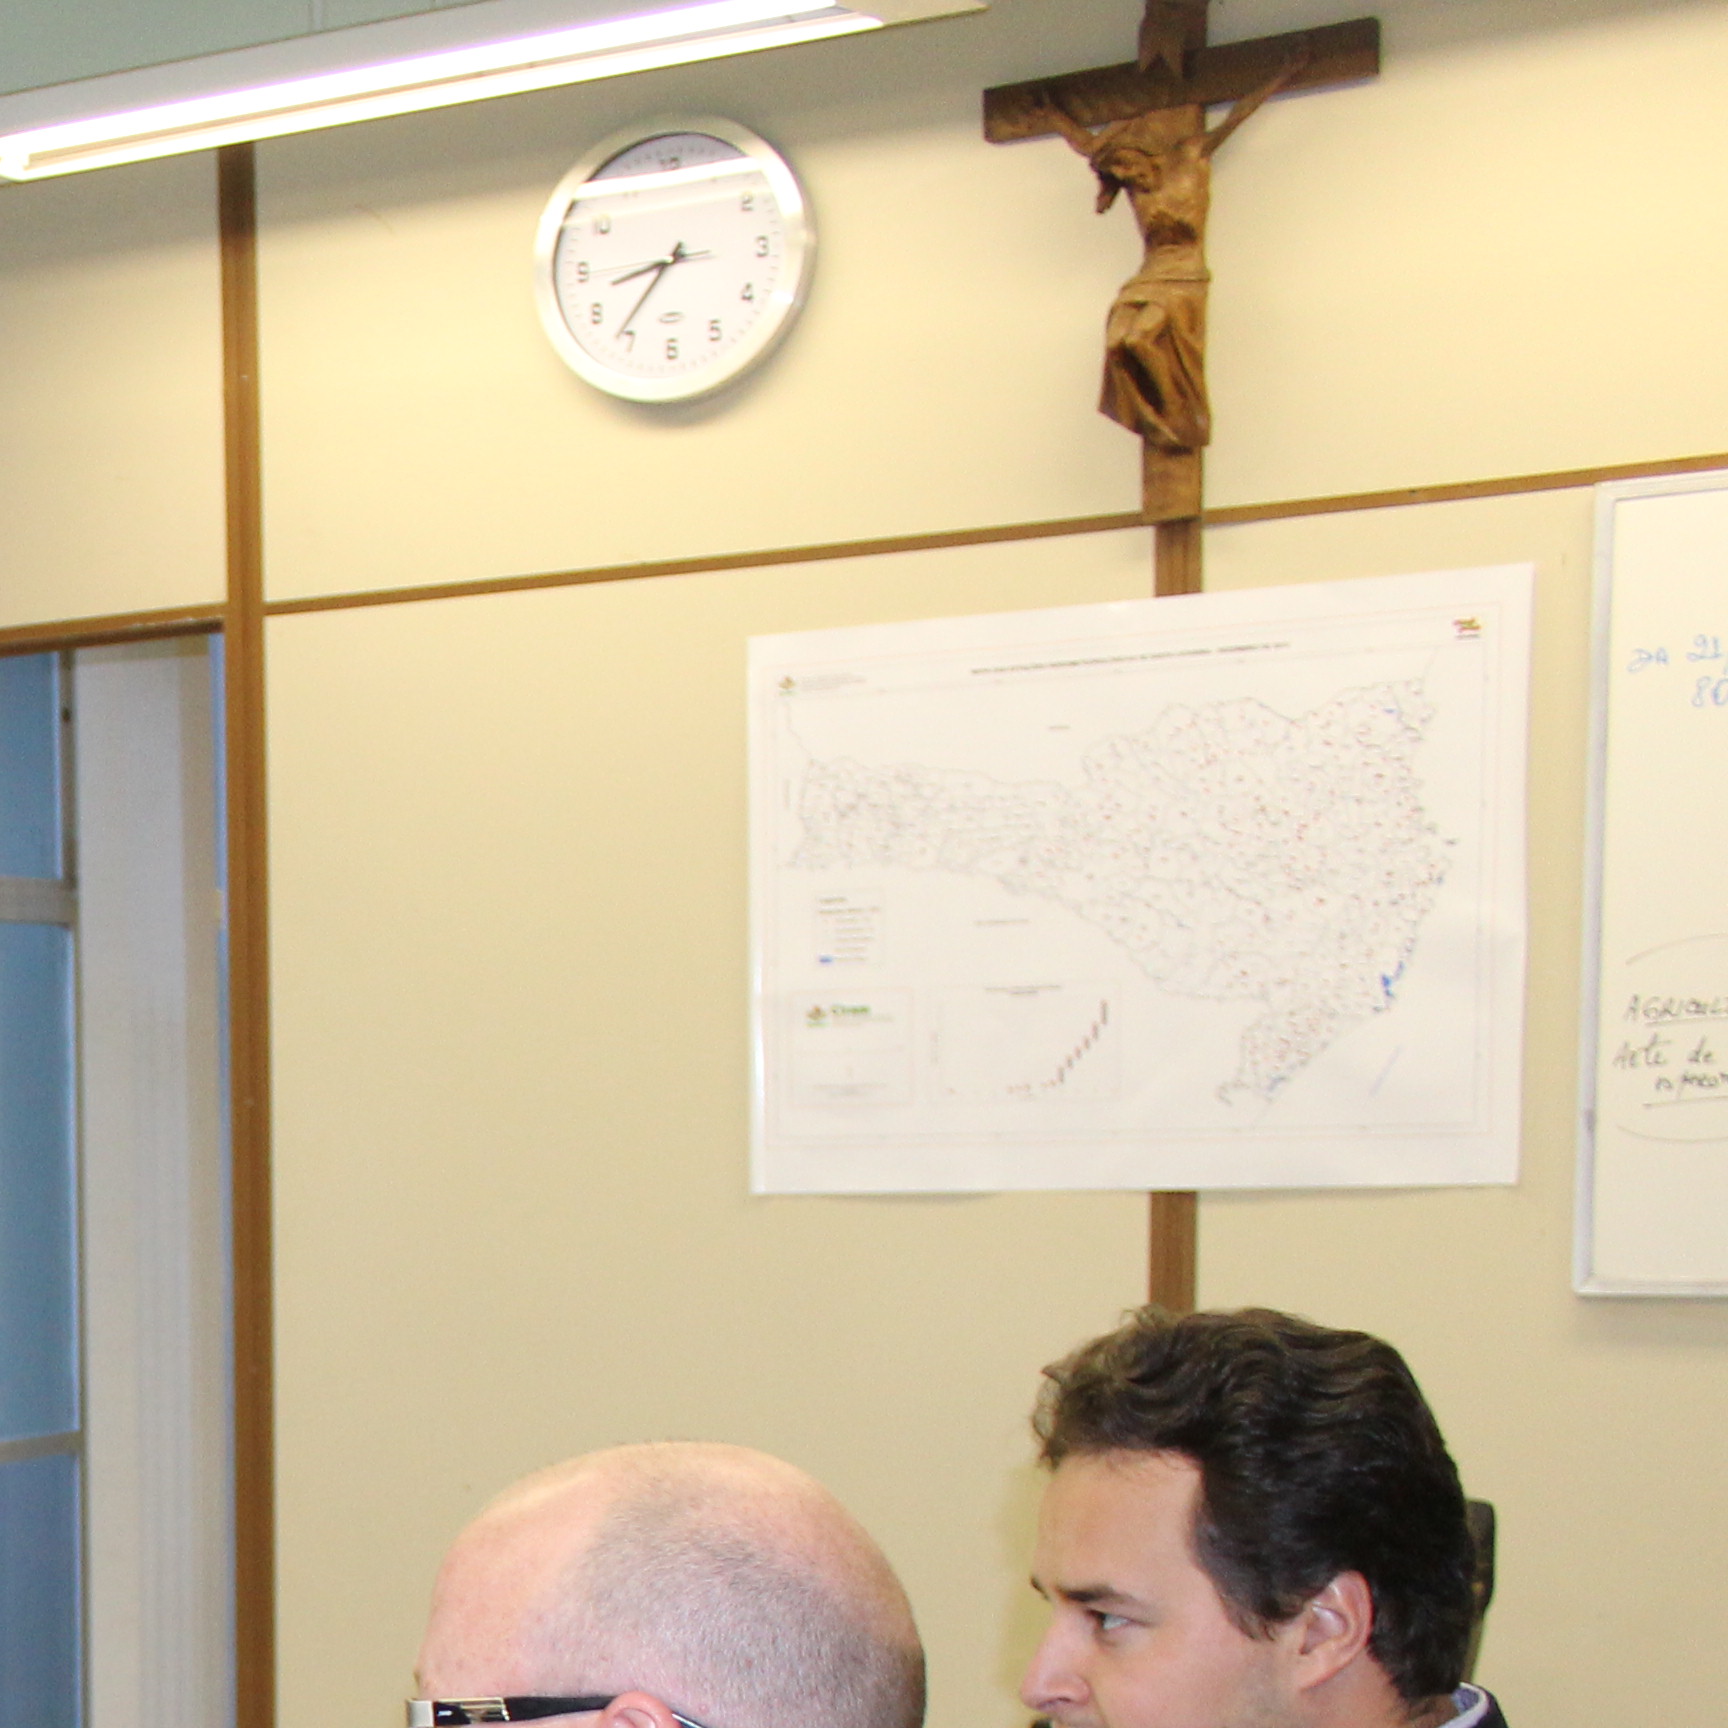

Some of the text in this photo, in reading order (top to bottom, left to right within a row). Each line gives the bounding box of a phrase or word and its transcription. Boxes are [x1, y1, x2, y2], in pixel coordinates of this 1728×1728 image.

[755, 234, 769, 258] 3
[577, 261, 589, 283] 9
[741, 282, 754, 302] 4
[591, 302, 603, 324] 8
[624, 329, 636, 353] 7
[708, 318, 722, 342] 5
[666, 337, 679, 360] 6
